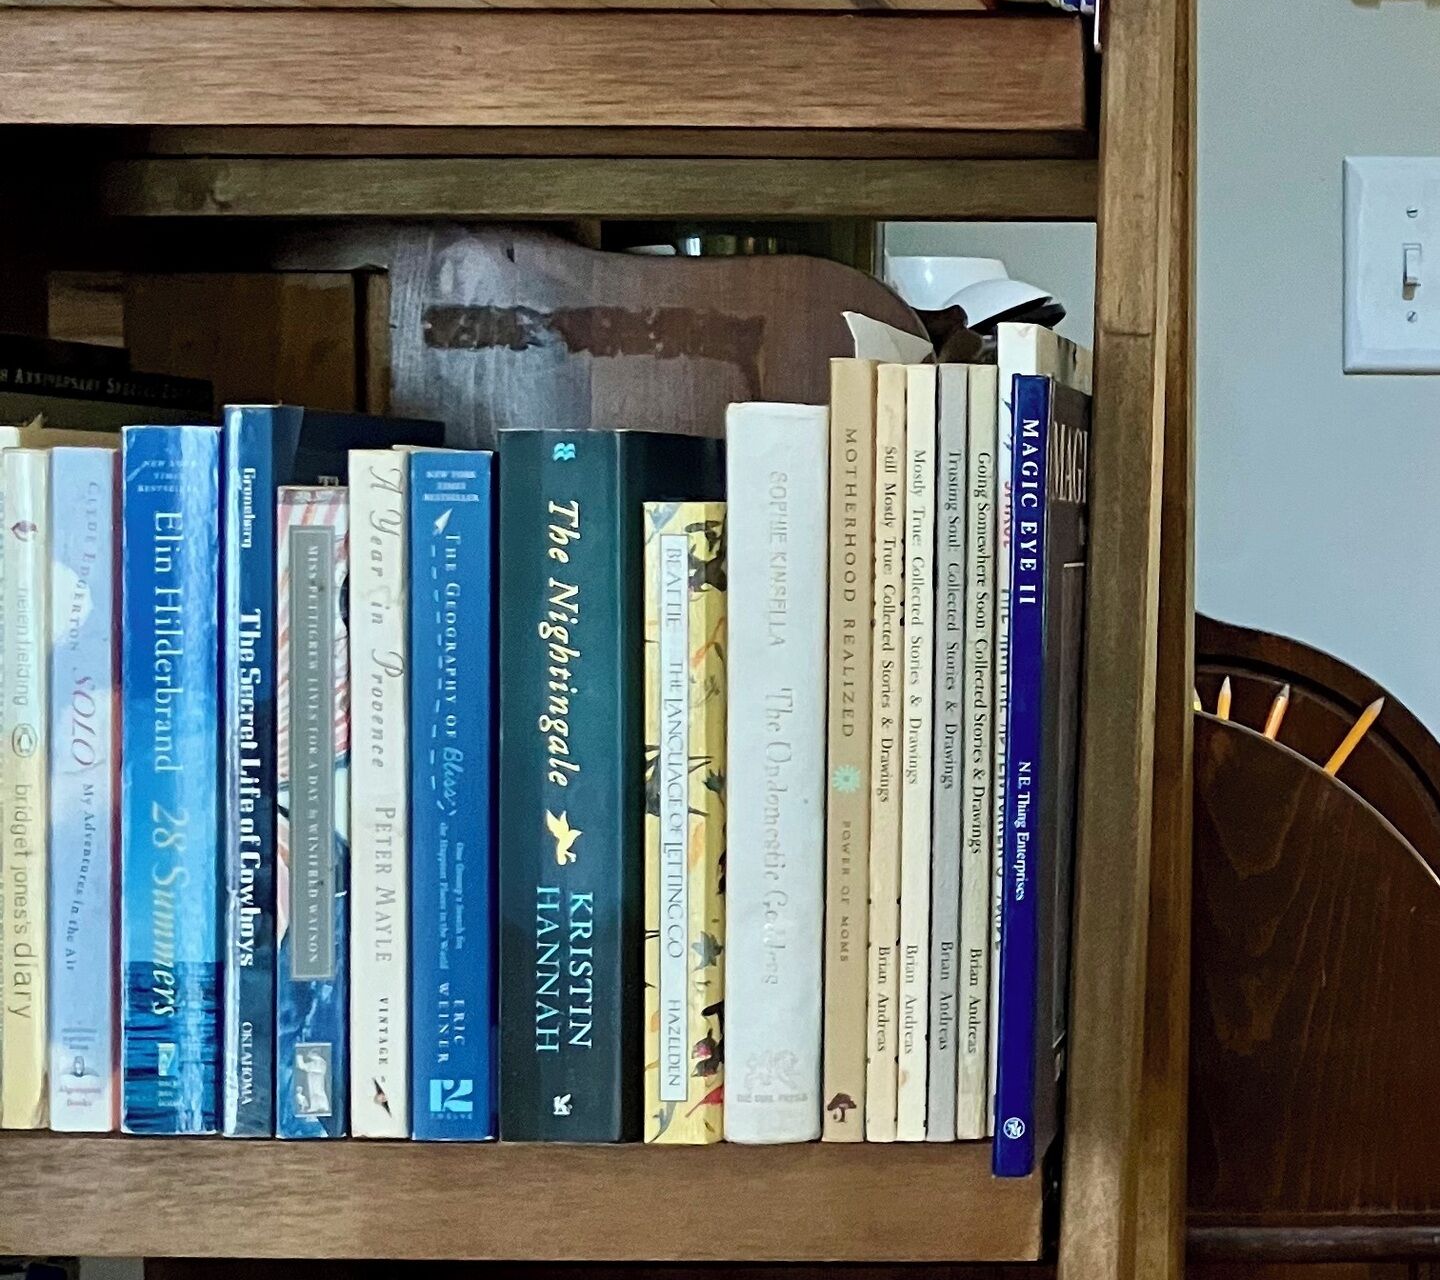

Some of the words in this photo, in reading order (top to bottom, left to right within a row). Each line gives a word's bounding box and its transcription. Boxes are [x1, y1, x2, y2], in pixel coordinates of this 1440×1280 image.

[974, 452, 991, 497] Going
[1022, 419, 1039, 509] MAGIC
[154, 511, 183, 573] Elin
[548, 500, 581, 563] The
[845, 427, 857, 604] MOTHERHOOD
[977, 502, 990, 586] Somewhere
[1020, 521, 1038, 570] EYE
[976, 589, 989, 629] Soon:
[1019, 584, 1036, 604] II
[240, 608, 261, 662] The
[154, 587, 184, 772] Hilderbrand
[538, 578, 581, 787] Nightingale
[842, 619, 855, 737] REALIZED
[974, 638, 989, 707] Collected
[239, 669, 261, 750] Secret
[973, 710, 988, 764] Stories
[239, 756, 260, 813] Life
[973, 768, 985, 779] &
[1018, 762, 1031, 788] N.E.
[10, 784, 33, 857] bridget
[153, 801, 190, 852] 28
[240, 819, 260, 848] of
[969, 785, 985, 854] Drawings
[1015, 792, 1031, 827] Thing
[10, 860, 32, 934] jones's
[1013, 832, 1029, 900] Enterprises
[152, 865, 190, 1018] Summers
[236, 851, 261, 967] Cowboys
[8, 944, 38, 1019] diary
[536, 886, 560, 1053] HANNAH
[569, 892, 593, 1049] KRISTIN
[969, 948, 982, 986] Brian
[378, 998, 388, 1065] VINTAGE
[668, 1000, 682, 1087] HAZELDEN
[968, 995, 982, 1055] Andreas
[241, 1021, 253, 1105] OKLAHOMA
